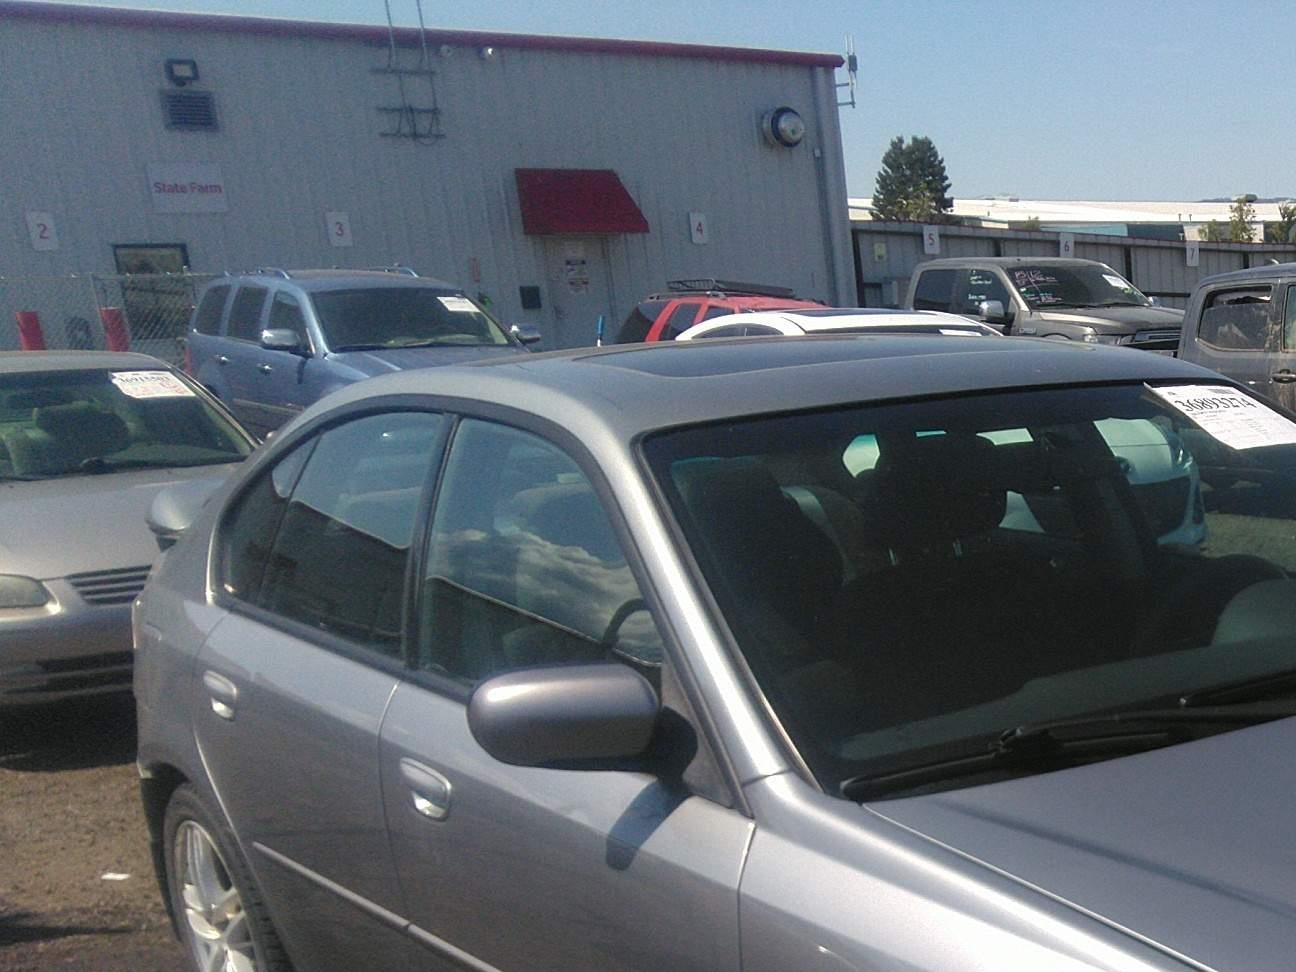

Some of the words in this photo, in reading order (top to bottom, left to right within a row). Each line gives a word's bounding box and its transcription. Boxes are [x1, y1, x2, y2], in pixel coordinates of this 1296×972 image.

[153, 181, 188, 193] State
[190, 181, 223, 193] Farm
[37, 223, 49, 240] 2
[335, 221, 344, 236] 3
[696, 221, 704, 237] 4
[928, 232, 936, 246] 5
[1064, 240, 1070, 252] 6
